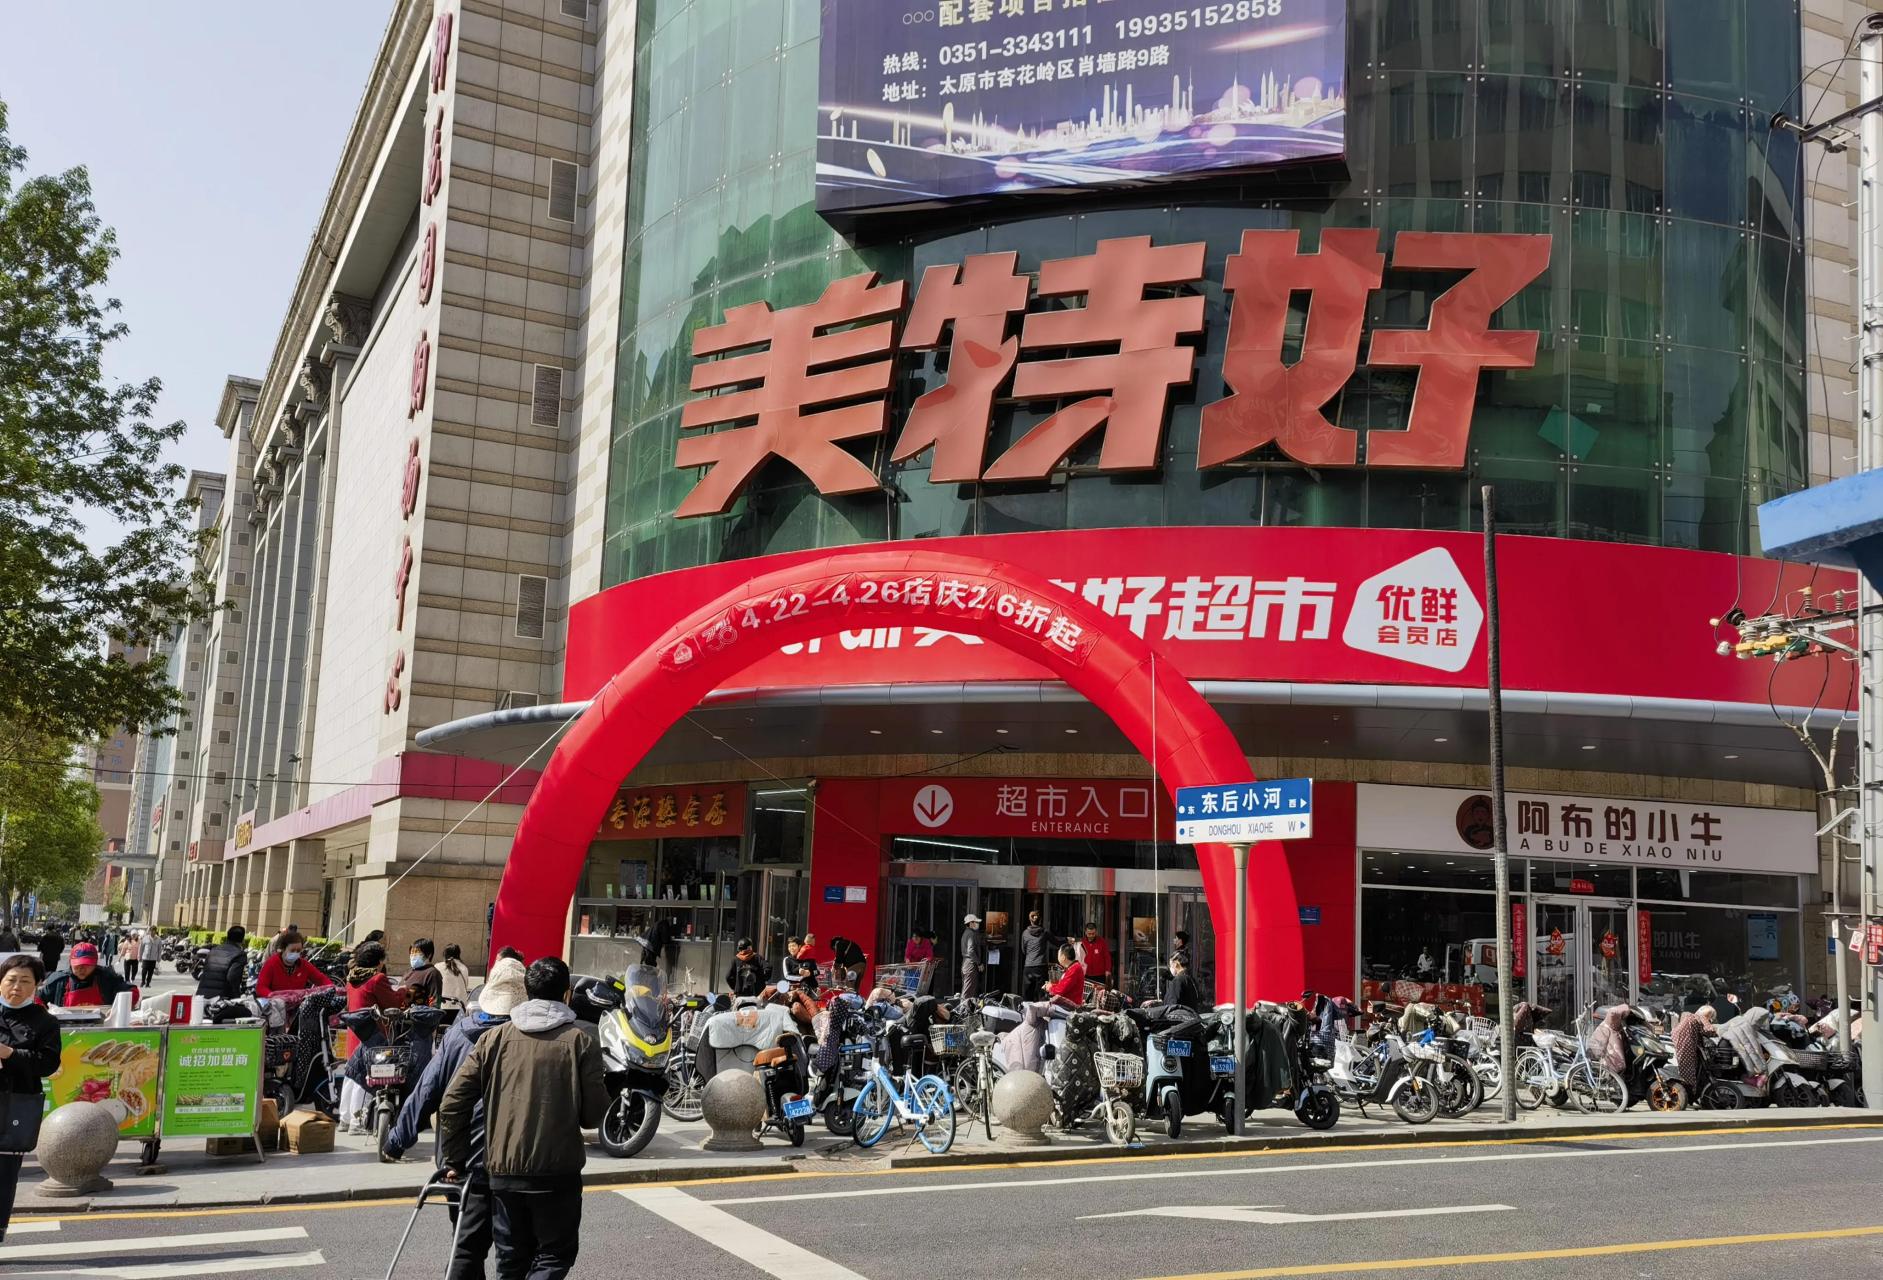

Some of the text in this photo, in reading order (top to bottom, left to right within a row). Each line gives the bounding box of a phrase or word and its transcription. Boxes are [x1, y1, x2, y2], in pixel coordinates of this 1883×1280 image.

[938, 0, 1114, 27] 配套项
[938, 25, 1093, 65] 0351-3343111
[1115, 0, 1282, 40] 19935152858
[674, 228, 1553, 519] 美特好
[1377, 584, 1458, 625] 优鲜
[1377, 626, 1458, 648] 会员店
[996, 784, 1149, 818] 超市入口
[1187, 805, 1196, 815] 东
[1201, 787, 1282, 814] 东后小河
[1031, 821, 1110, 834] ENTERANCE
[1188, 821, 1296, 837] E DONGHOU XIAOHE W
[1517, 800, 1723, 846] 阿布的小牛
[1520, 837, 1723, 862] A BU DE XIAO NIU
